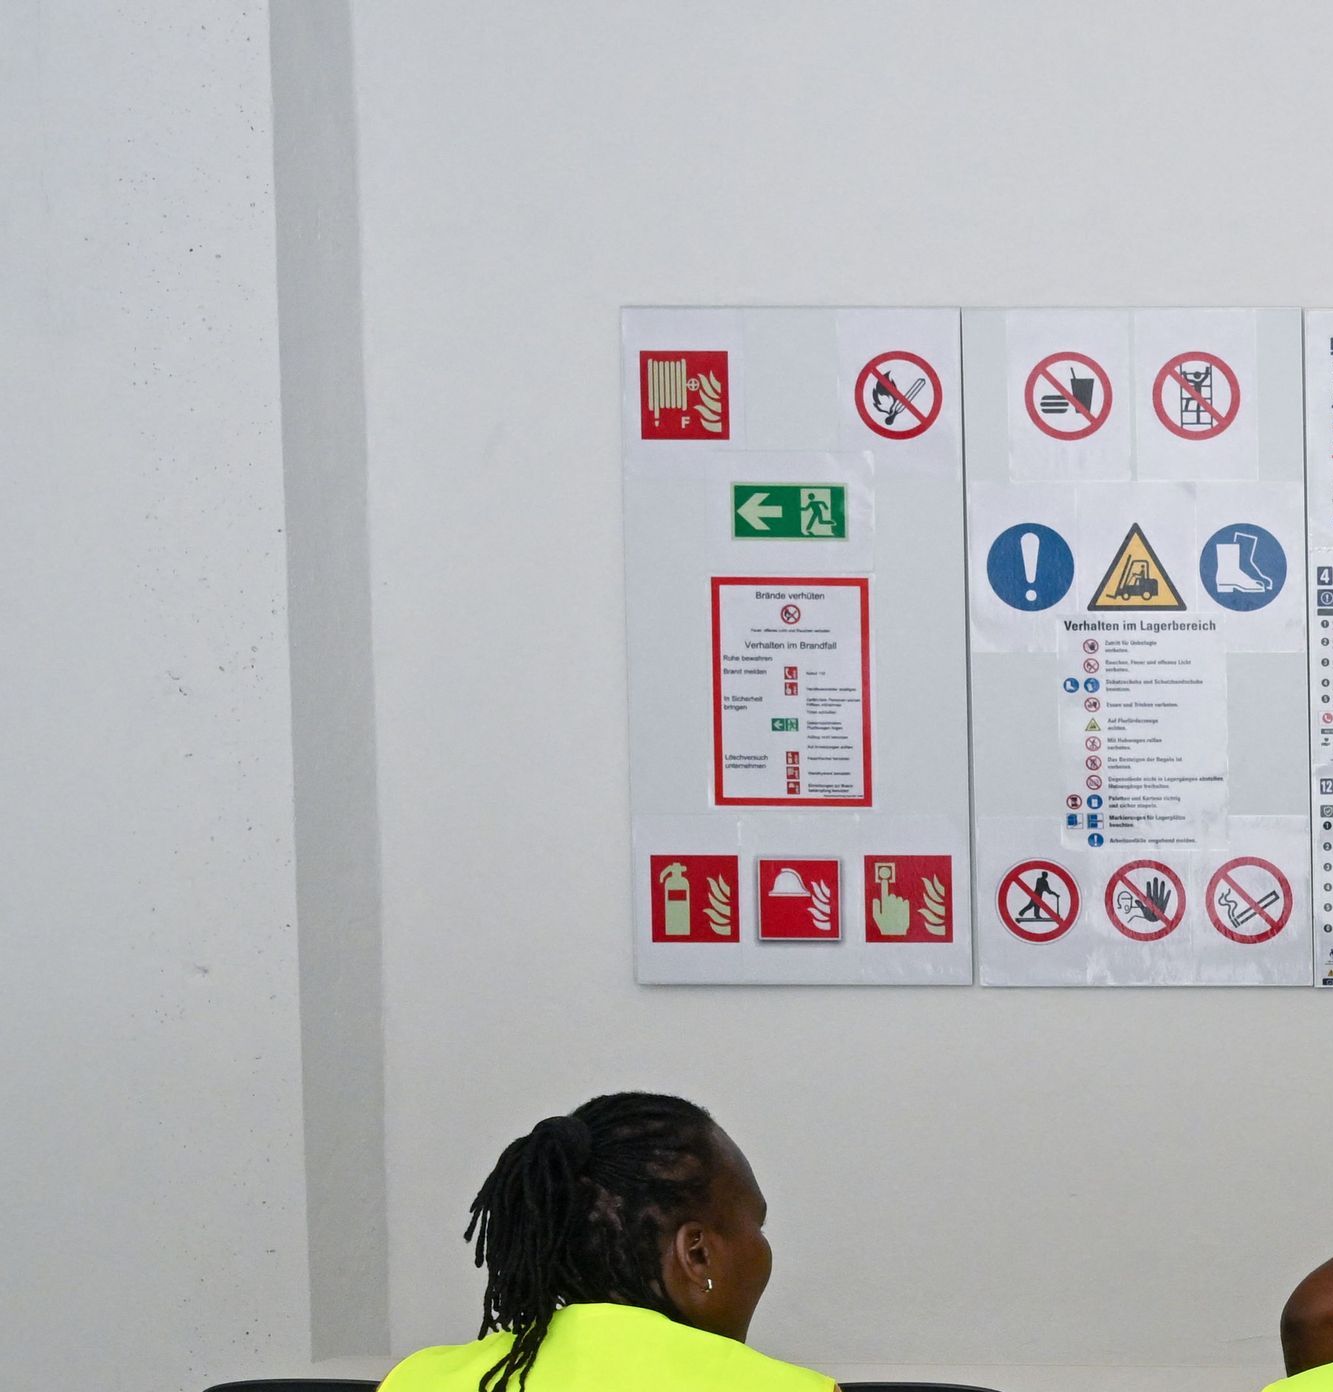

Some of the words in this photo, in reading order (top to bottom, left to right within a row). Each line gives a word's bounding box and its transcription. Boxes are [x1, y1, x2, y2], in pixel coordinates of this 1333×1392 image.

[681, 416, 691, 429] F
[1319, 567, 1330, 584] 4
[755, 592, 786, 600] Brände
[788, 592, 825, 600] verhüten
[1063, 620, 1119, 632] Verhalten
[1123, 620, 1137, 631] im
[1140, 620, 1217, 633] Lagerbereich
[744, 641, 785, 650] Verhalten
[787, 641, 798, 650] im
[799, 641, 838, 650] Brandfall
[723, 703, 748, 712] bringen
[1320, 780, 1333, 794] 12
